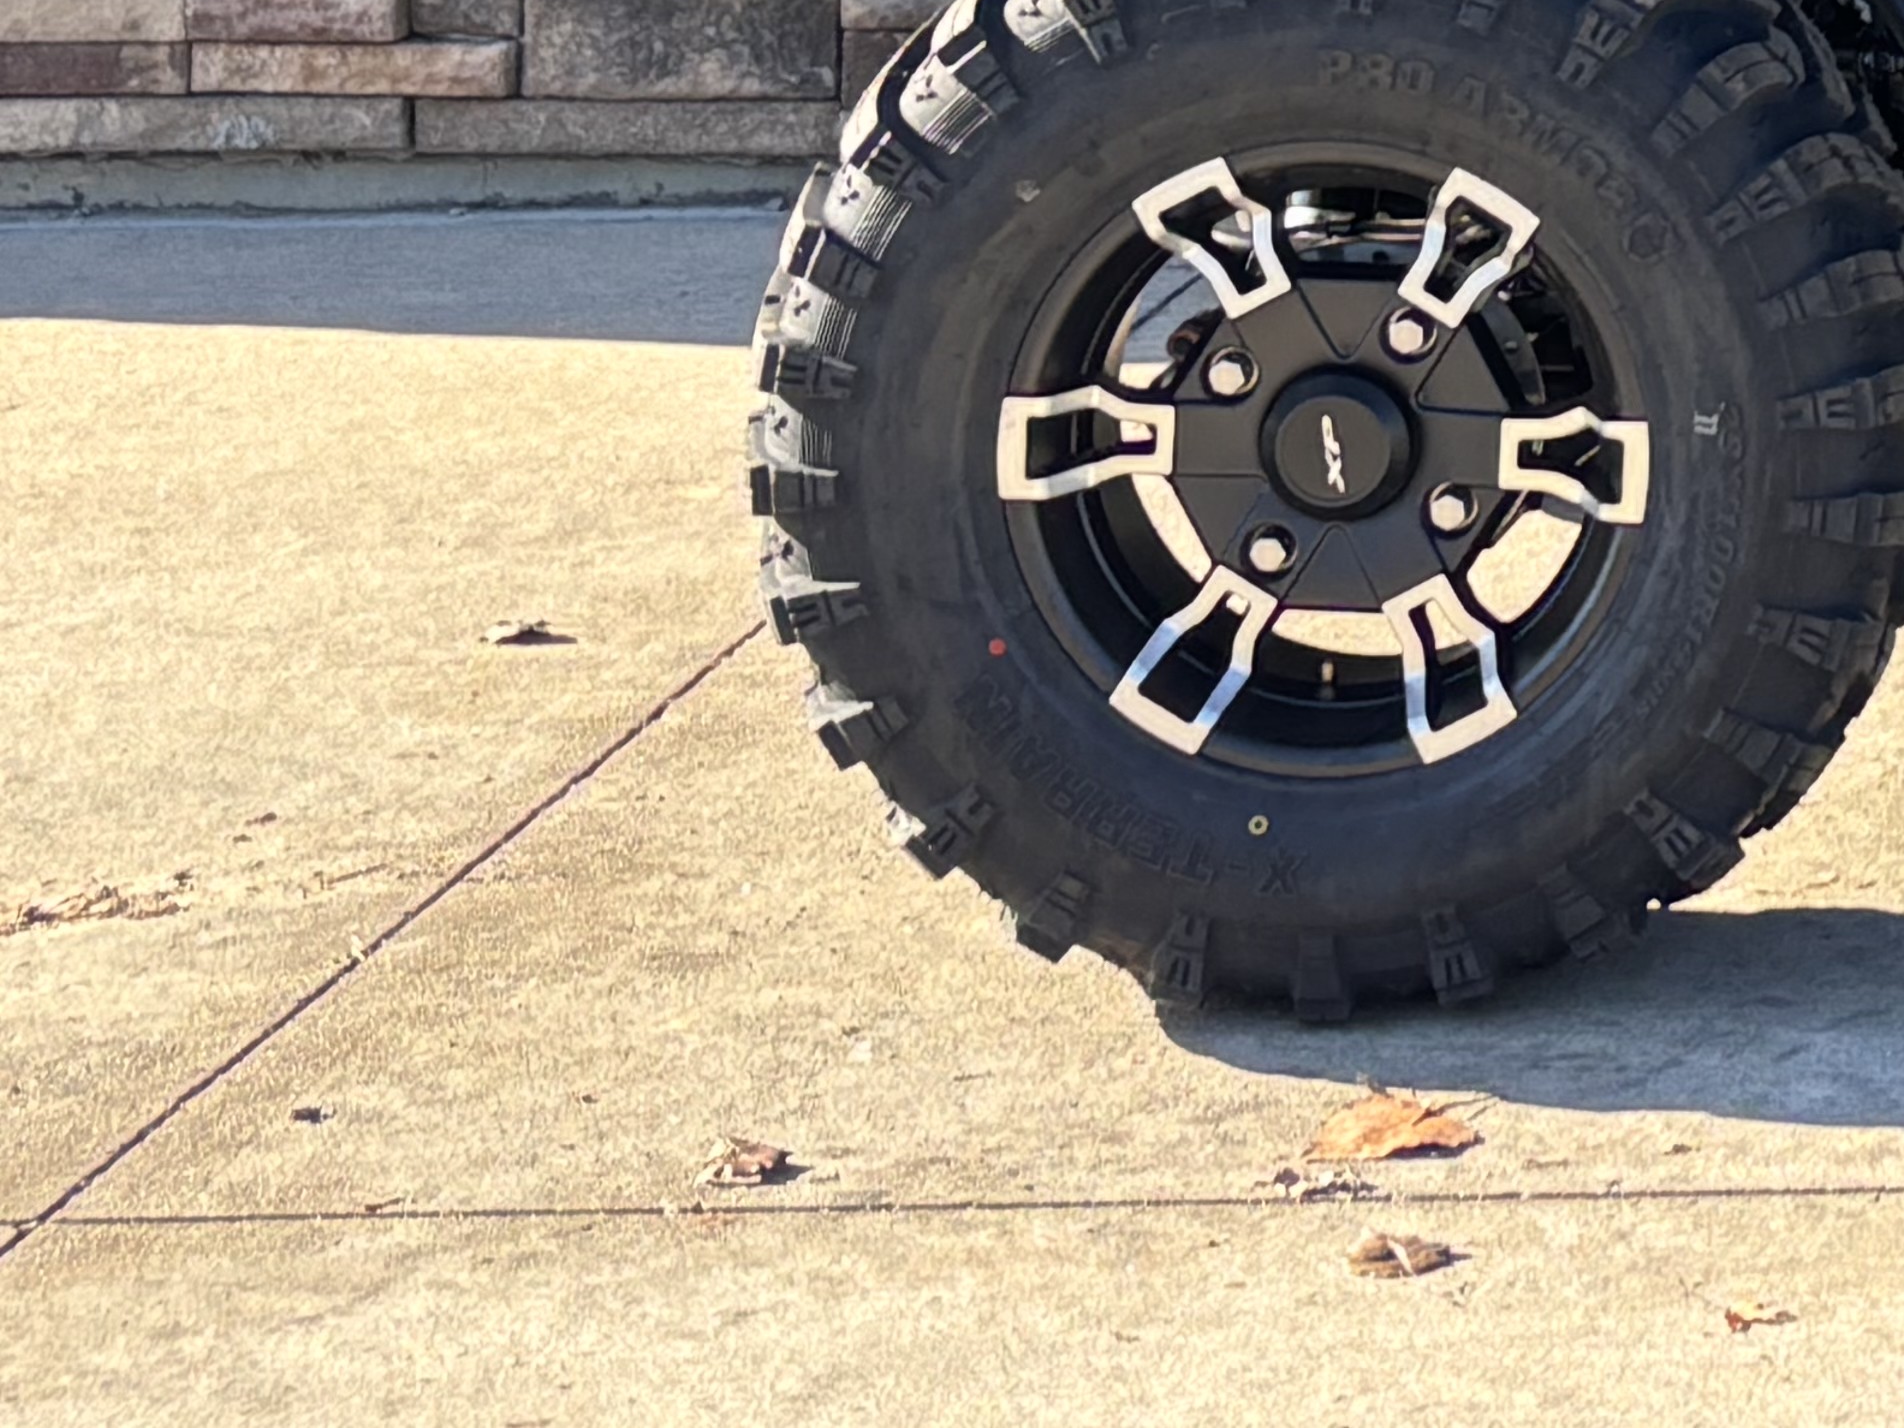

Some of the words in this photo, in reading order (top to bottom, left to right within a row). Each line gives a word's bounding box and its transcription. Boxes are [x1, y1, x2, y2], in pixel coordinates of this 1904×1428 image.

[1317, 48, 1438, 92] PRO
[1453, 74, 1638, 214] ARMOR
[953, 672, 1308, 896] X-TERRAIN
